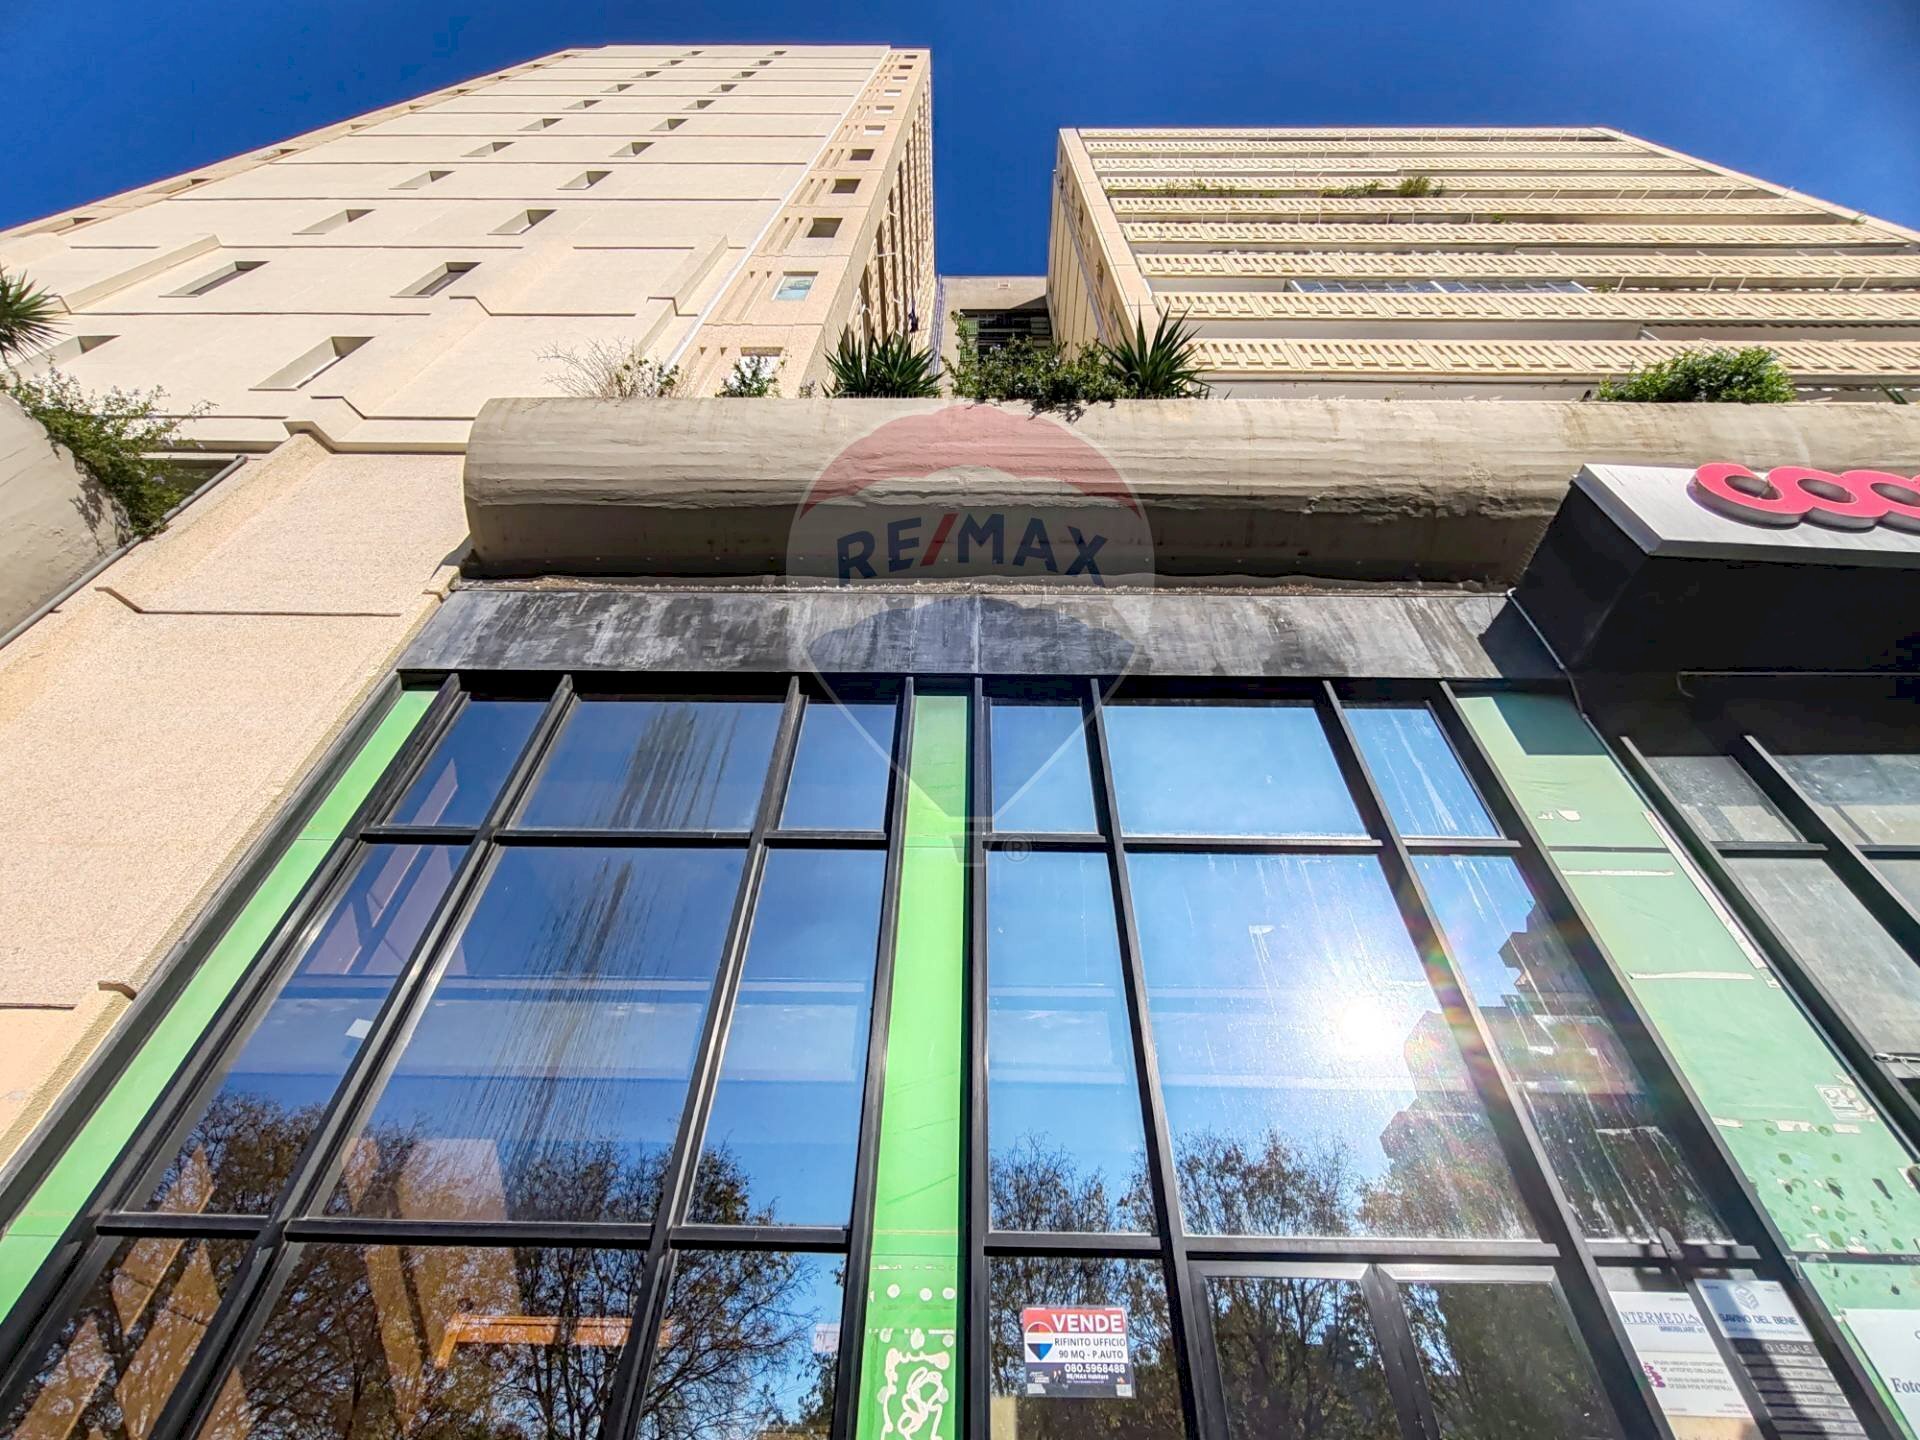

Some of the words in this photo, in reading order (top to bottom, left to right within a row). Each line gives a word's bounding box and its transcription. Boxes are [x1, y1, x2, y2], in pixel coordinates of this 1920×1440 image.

[1691, 462, 1920, 522] coo
[1051, 1314, 1123, 1332] VENDE
[1618, 1311, 1705, 1327] NTERMEDIA
[1054, 1337, 1091, 1347] RIFINITO
[1093, 1337, 1126, 1347] UFFICIO
[1058, 1350, 1069, 1359] 90
[1070, 1350, 1085, 1360] MQ
